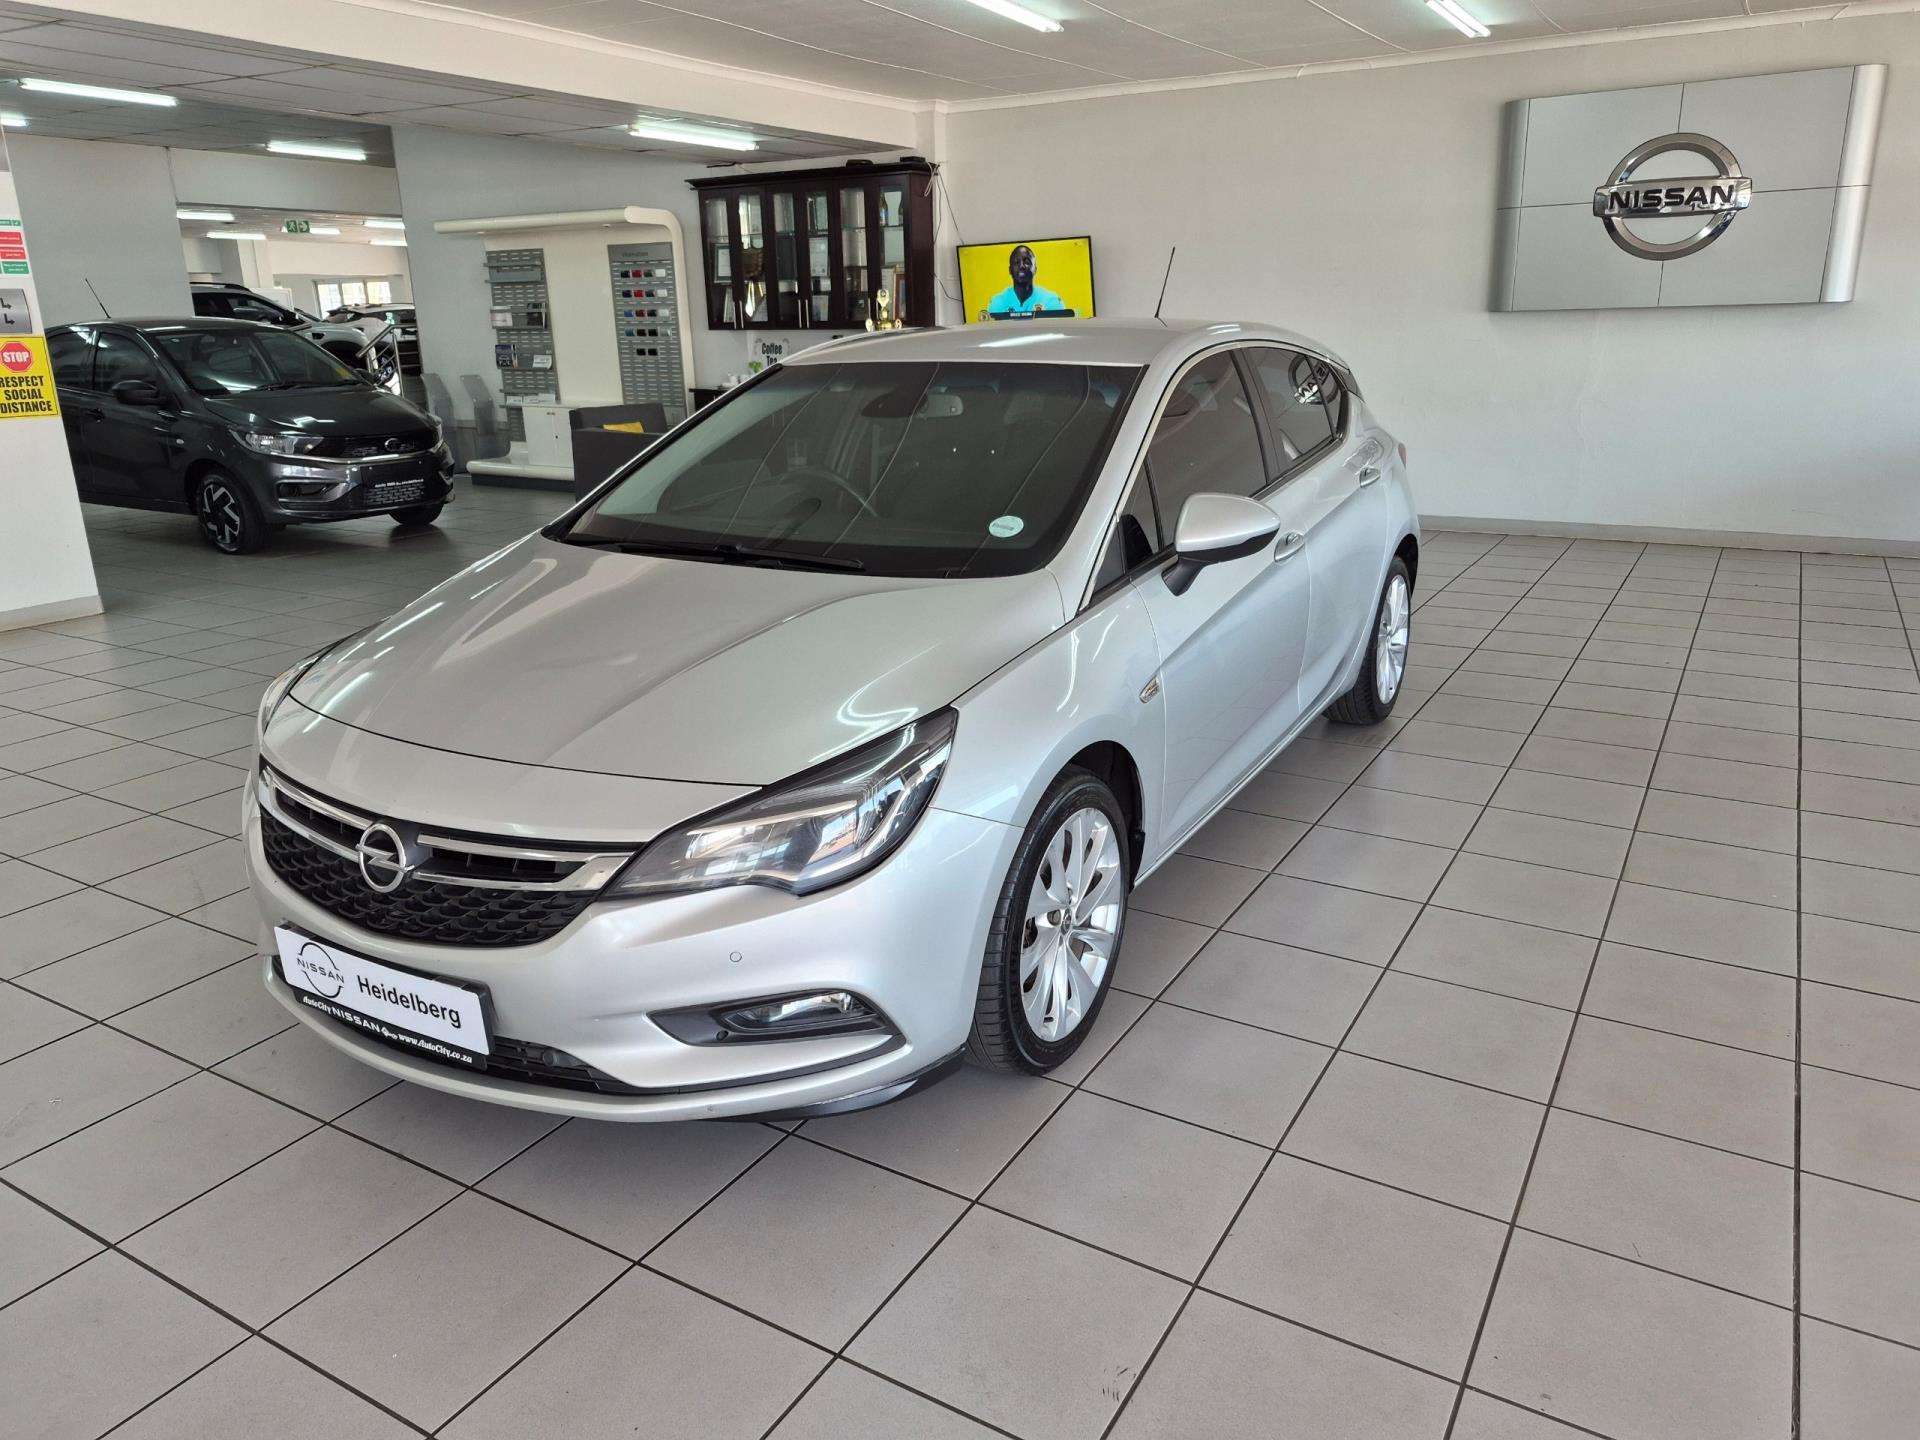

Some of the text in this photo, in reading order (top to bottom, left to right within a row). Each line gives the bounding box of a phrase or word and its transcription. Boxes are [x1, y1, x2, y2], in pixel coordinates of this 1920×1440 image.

[1609, 184, 1735, 210] NISSAN
[761, 342, 783, 355] Coffee
[2, 351, 30, 364] STOP
[0, 375, 44, 388] RESPECT
[4, 388, 44, 401] SOCIAL
[0, 400, 53, 414] DISTANCE
[297, 957, 345, 984] NISSAN
[357, 974, 462, 1029] Heidelberg
[302, 995, 473, 1064] AutoCity NISSAN www.AutoCity.co.za
